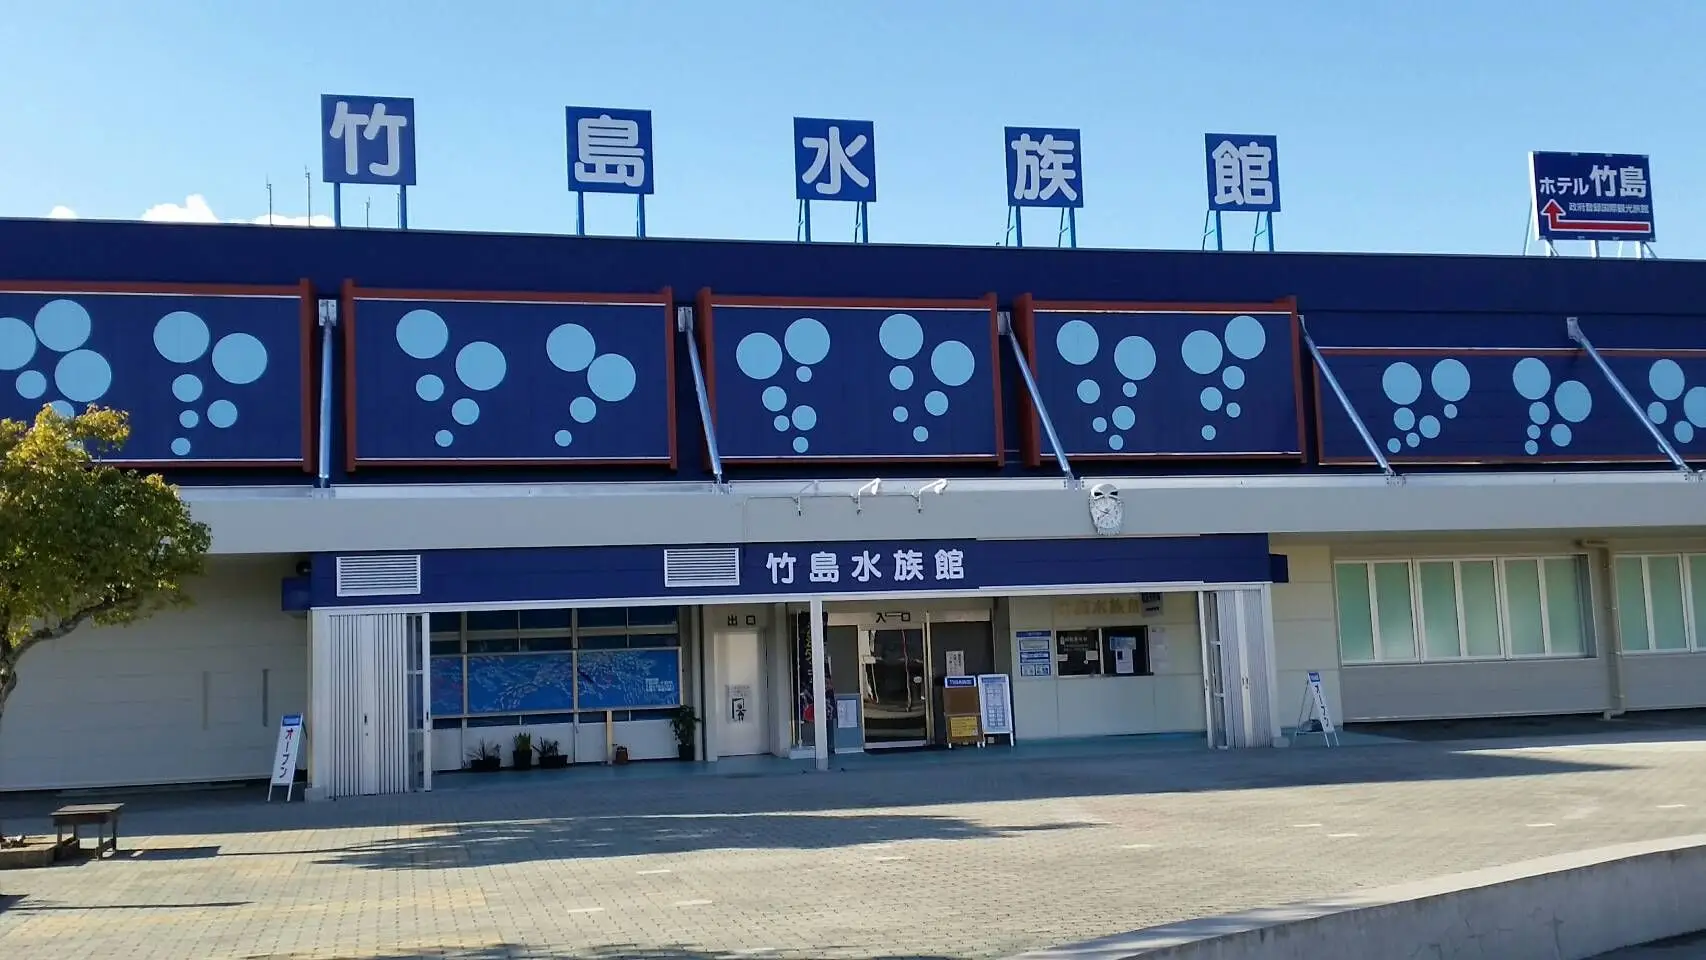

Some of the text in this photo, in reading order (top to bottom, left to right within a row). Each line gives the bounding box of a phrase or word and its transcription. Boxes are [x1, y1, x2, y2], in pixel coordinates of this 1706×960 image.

[766, 549, 965, 584] 竹島水族館
[727, 615, 756, 626] 出口
